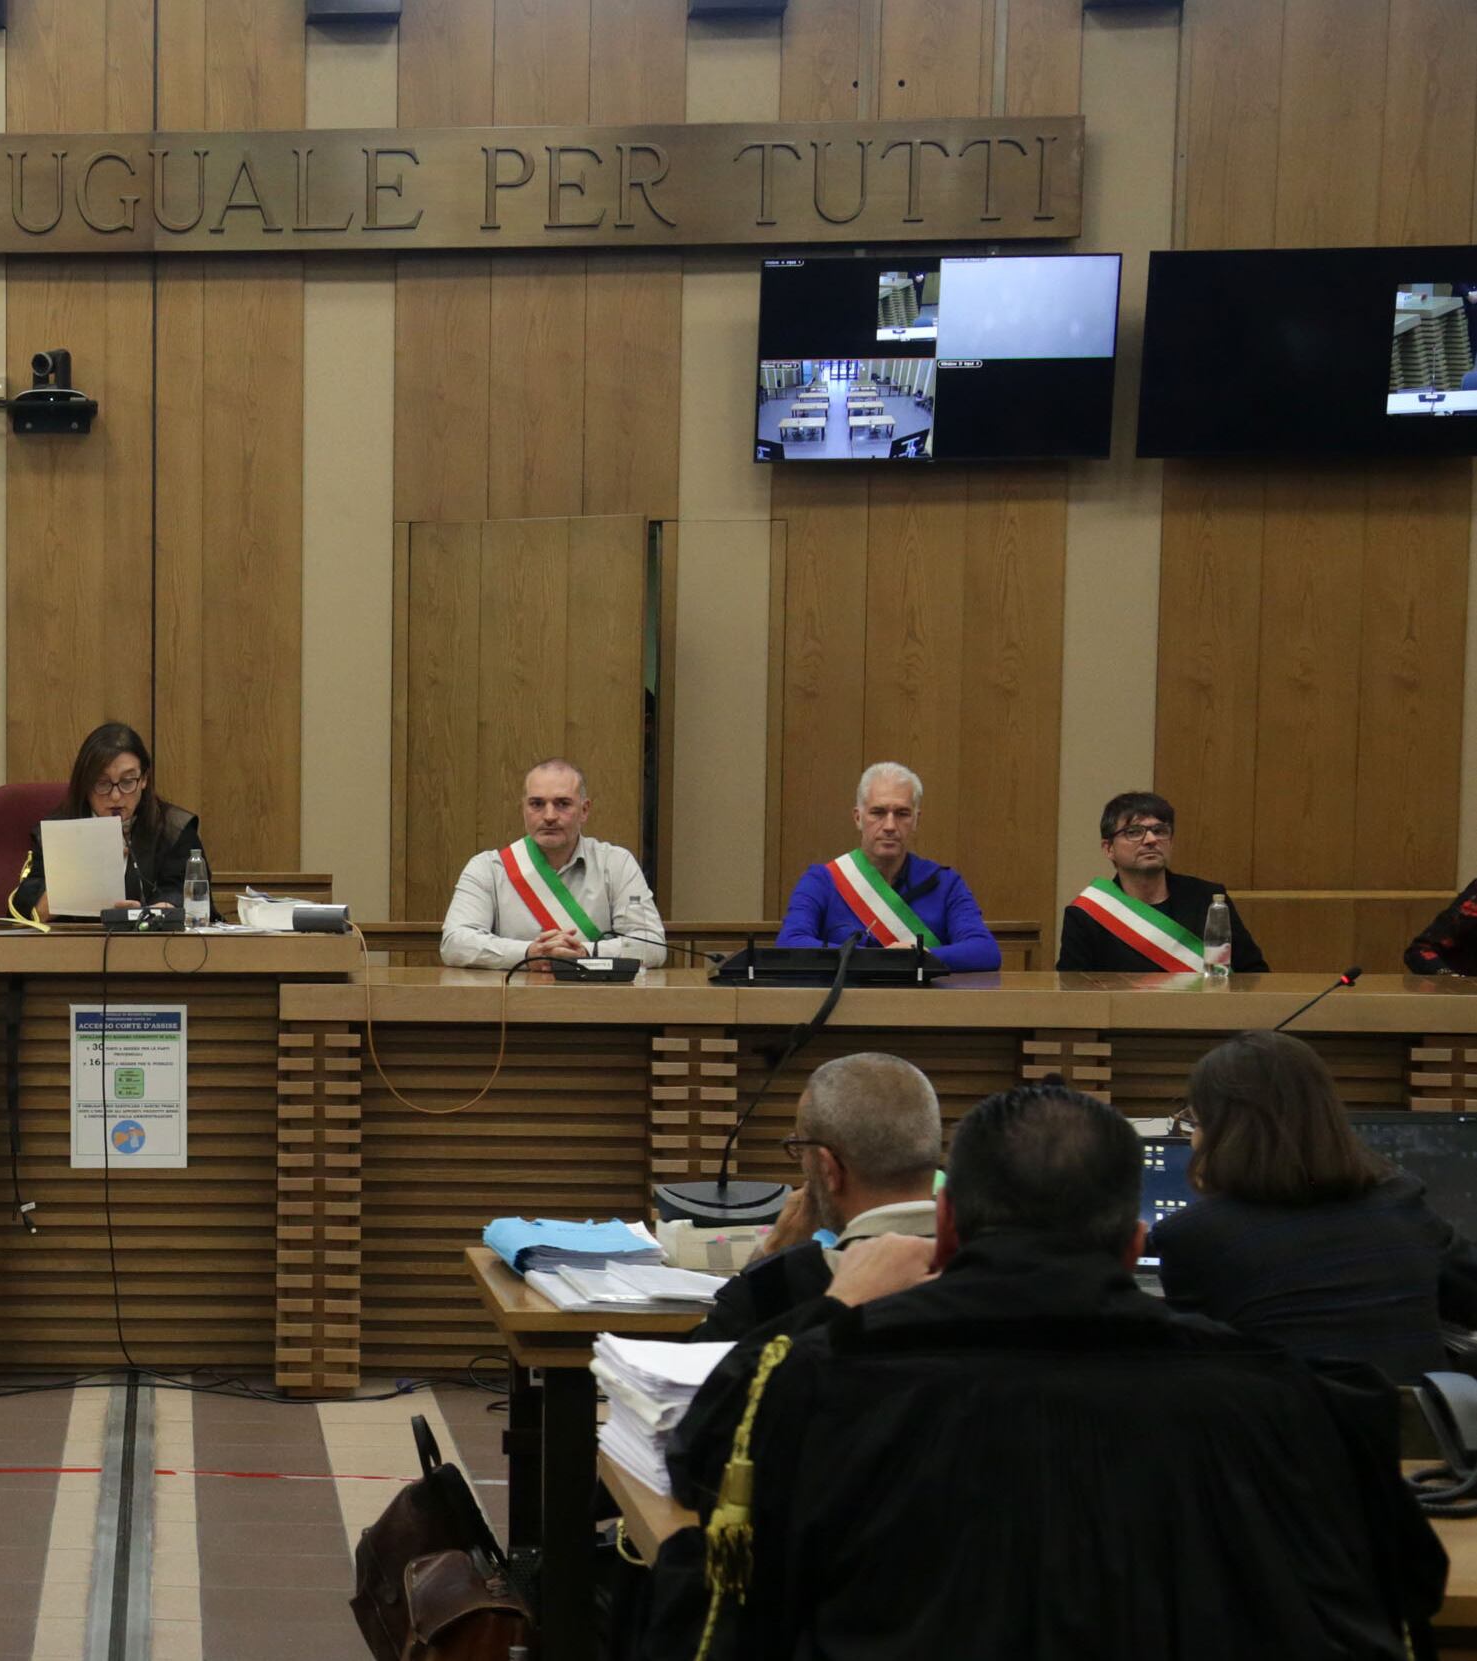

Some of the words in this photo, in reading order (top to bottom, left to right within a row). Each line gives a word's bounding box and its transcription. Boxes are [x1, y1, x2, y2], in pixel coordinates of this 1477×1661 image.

[6, 147, 424, 235] UGUALE
[479, 142, 677, 230] PER
[732, 135, 1058, 227] TUTTI
[90, 1058, 101, 1066] 16
